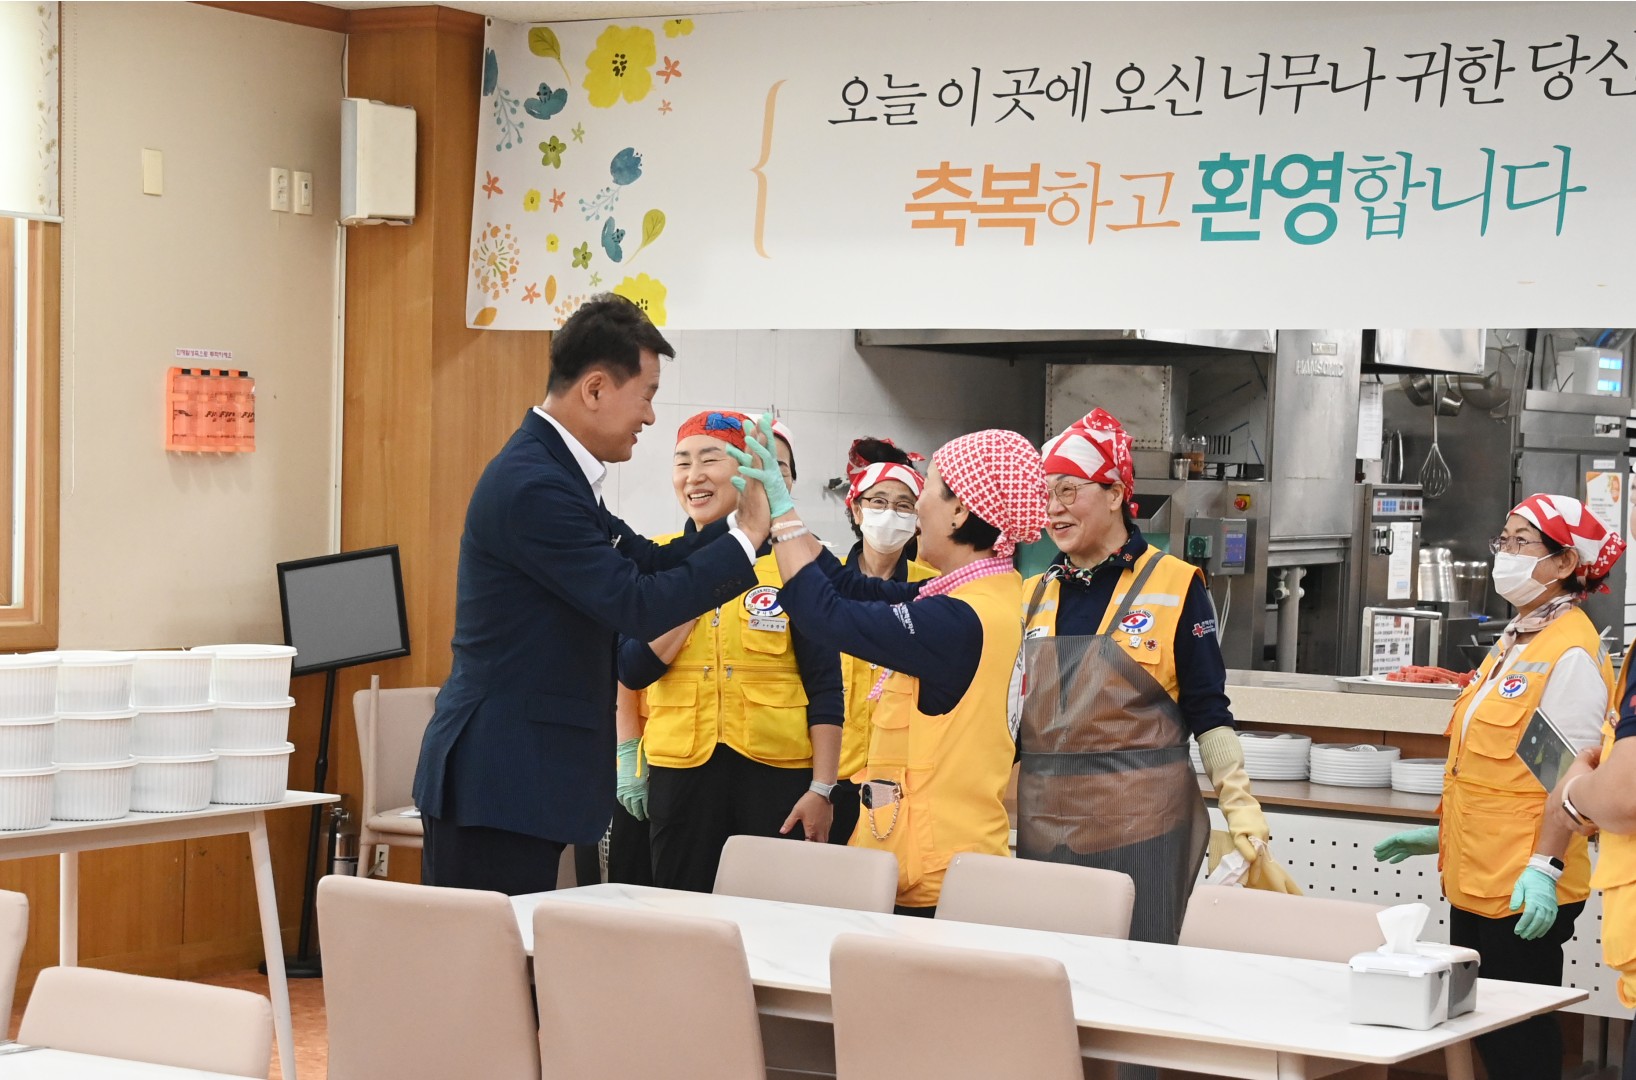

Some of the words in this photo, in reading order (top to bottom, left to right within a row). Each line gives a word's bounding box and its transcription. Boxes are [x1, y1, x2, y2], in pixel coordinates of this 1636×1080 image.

[828, 73, 928, 126] 오늘
[938, 66, 981, 127] 이
[992, 61, 1092, 131] 곳에
[1100, 55, 1205, 117] 오신
[1220, 46, 1387, 116] 너무나
[1396, 38, 1516, 108] 귀한
[904, 160, 1181, 247] 축복하고
[1193, 145, 1586, 245] 환영합니다
